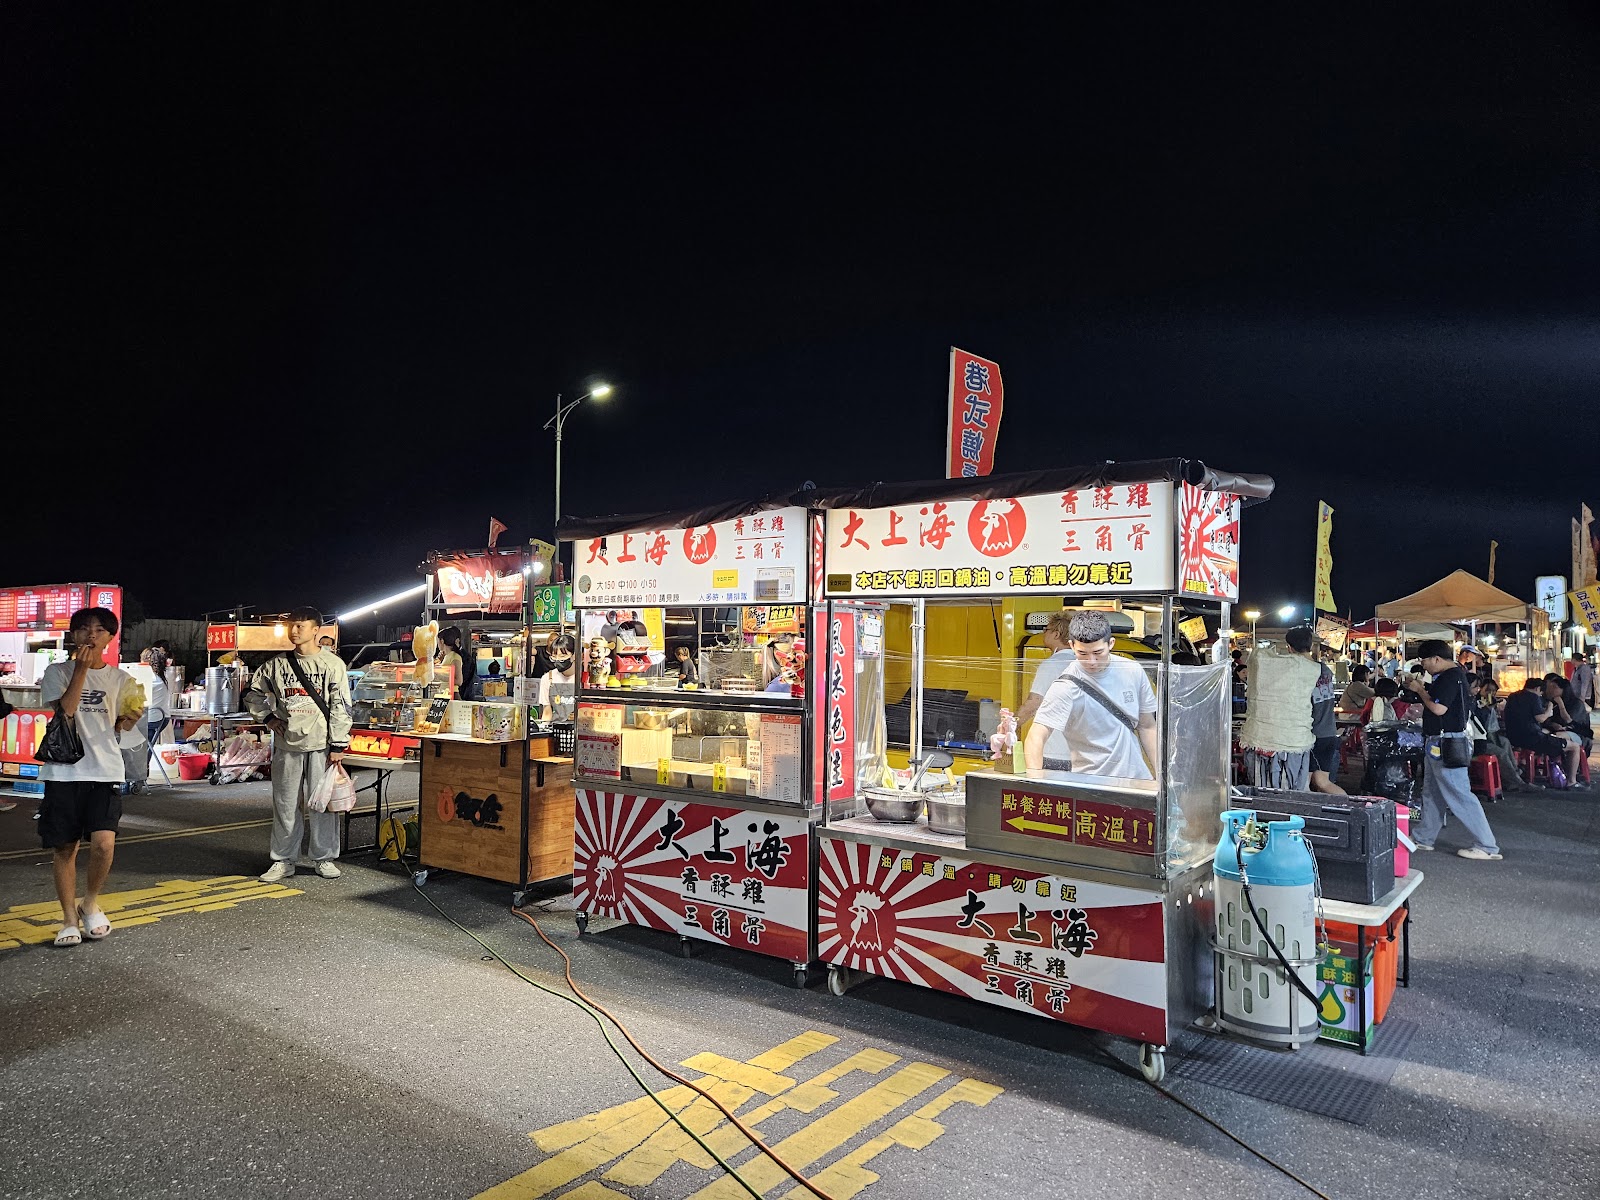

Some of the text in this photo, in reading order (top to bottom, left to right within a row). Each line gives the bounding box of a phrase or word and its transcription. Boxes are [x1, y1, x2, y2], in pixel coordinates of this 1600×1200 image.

[1061, 483, 1150, 516] 香酥雞
[734, 516, 785, 536] 香酥雞
[840, 502, 956, 551] 大上海
[1061, 521, 1150, 552] 三角骨
[587, 530, 671, 566] 大上海
[735, 541, 785, 560] 三角骨
[597, 578, 657, 590] 大150 中100 小50
[645, 594, 657, 603] 100
[79, 706, 109, 714] balance
[1002, 794, 1073, 820] 點餐結帳
[656, 809, 791, 878] 大上海
[681, 867, 766, 905] 香酥雞
[682, 905, 766, 944] 三角骨
[957, 890, 1098, 958] 大上海
[982, 942, 1070, 980] 香酥雞
[984, 975, 1070, 1013] 三角骨
